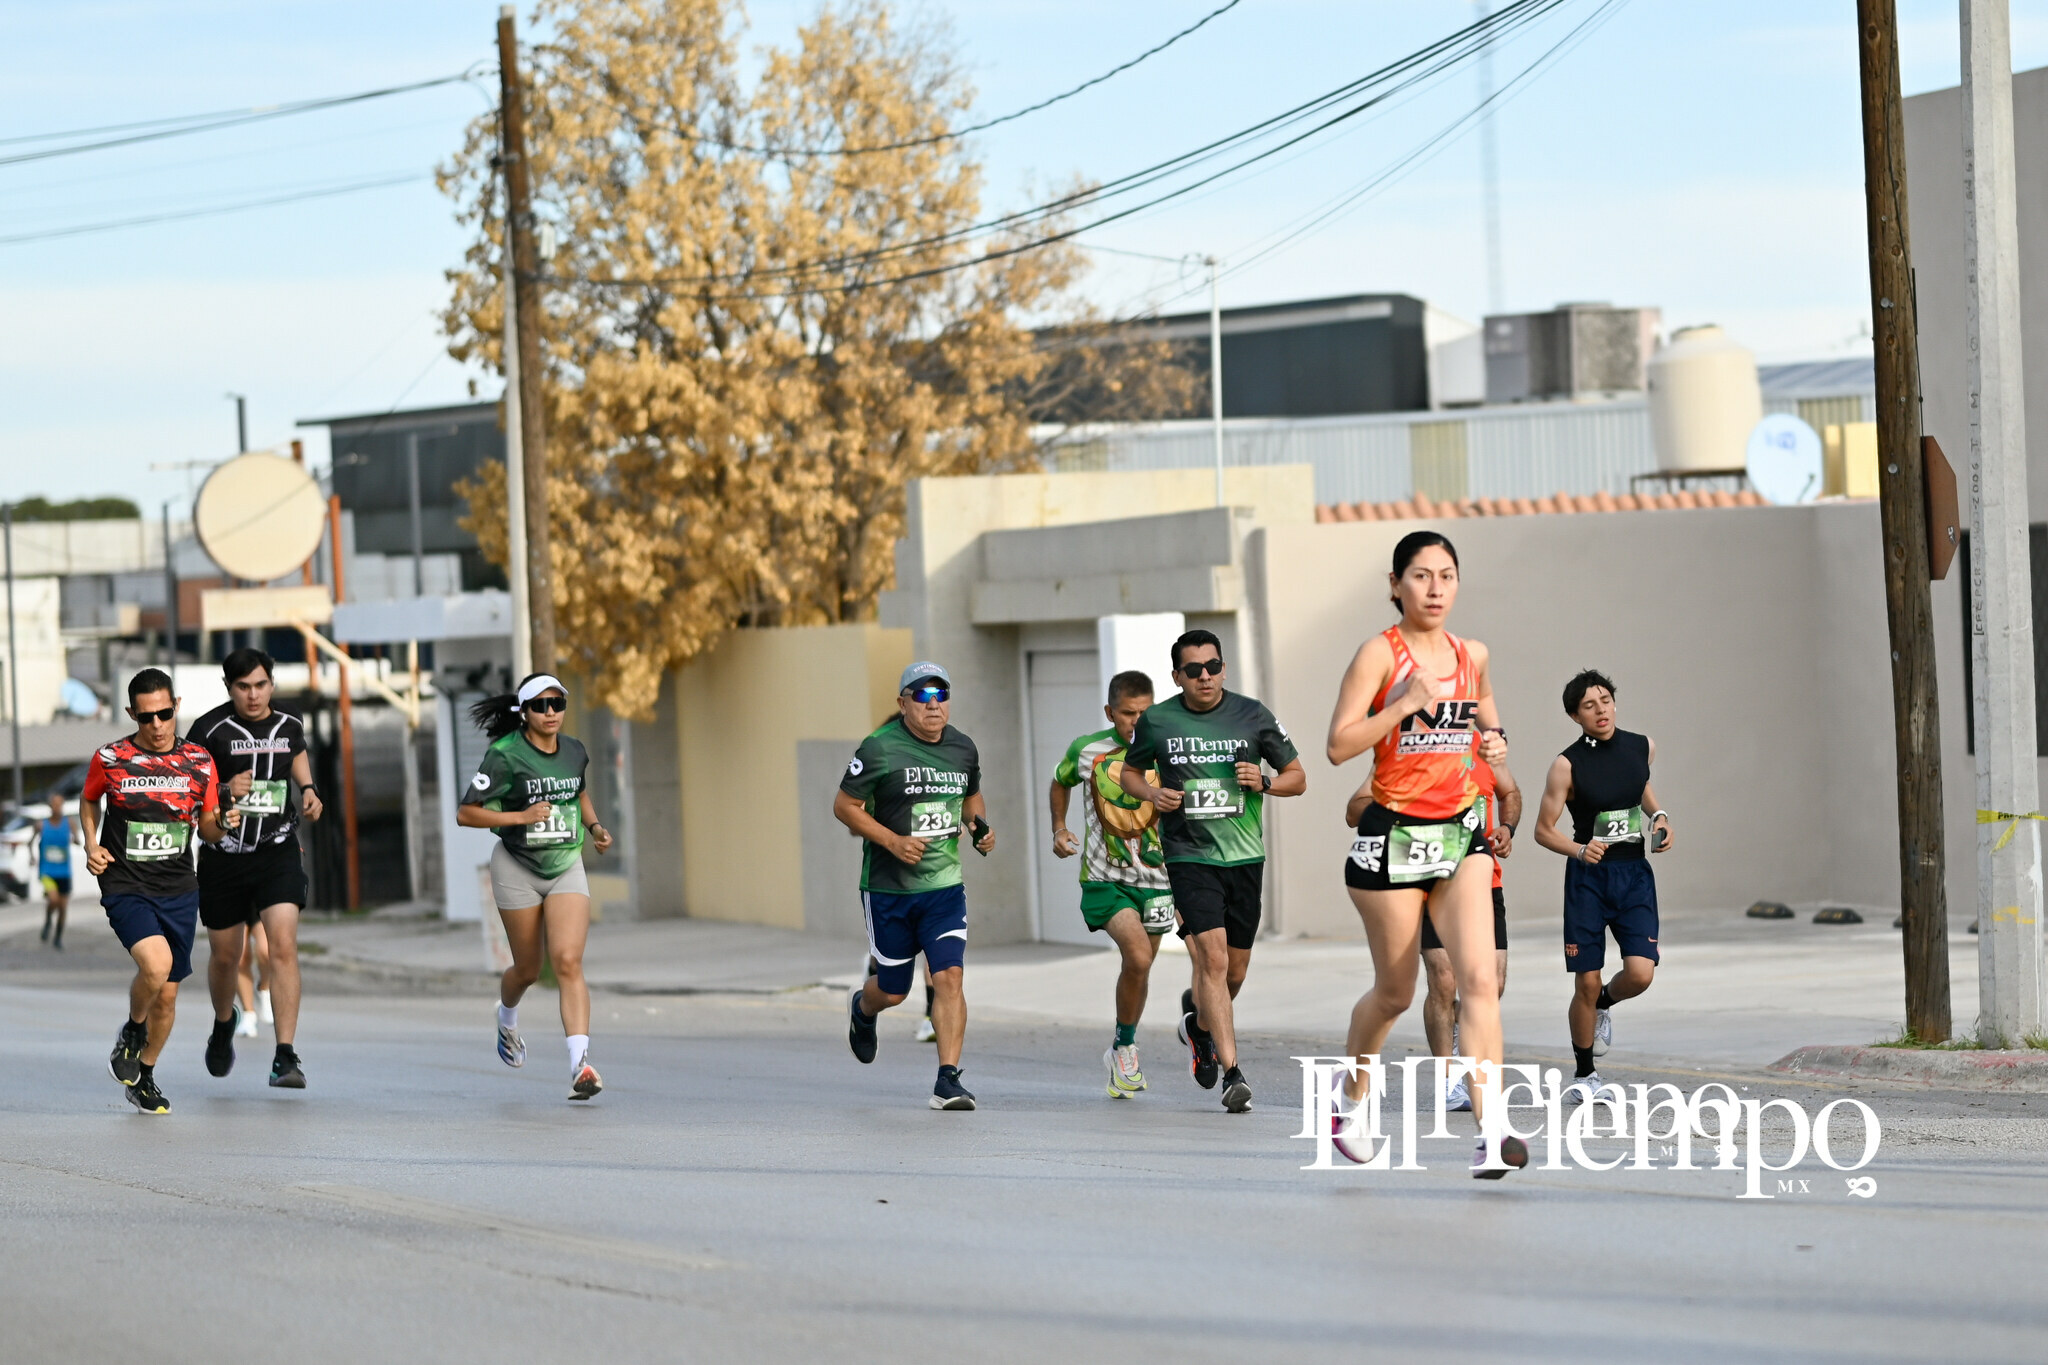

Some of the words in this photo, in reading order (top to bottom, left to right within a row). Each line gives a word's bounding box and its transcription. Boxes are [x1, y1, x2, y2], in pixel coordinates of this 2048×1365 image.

[231, 738, 290, 751] IRONCAST
[1167, 737, 1184, 753] El
[1186, 737, 1248, 753] Tiempo
[1170, 754, 1188, 765] de
[1189, 753, 1235, 764] todos
[122, 776, 190, 789] IRONCAST
[904, 767, 921, 783] El
[922, 767, 968, 786] Tiempo
[526, 779, 542, 794] El
[904, 785, 923, 794] de
[924, 784, 963, 794] todos
[529, 796, 543, 804] de
[545, 791, 576, 802] todos
[1191, 790, 1229, 807] 129
[918, 812, 952, 831] 239
[1607, 820, 1629, 837] 23
[135, 833, 173, 850] 160
[1408, 841, 1444, 865] 59
[1150, 904, 1175, 922] 530
